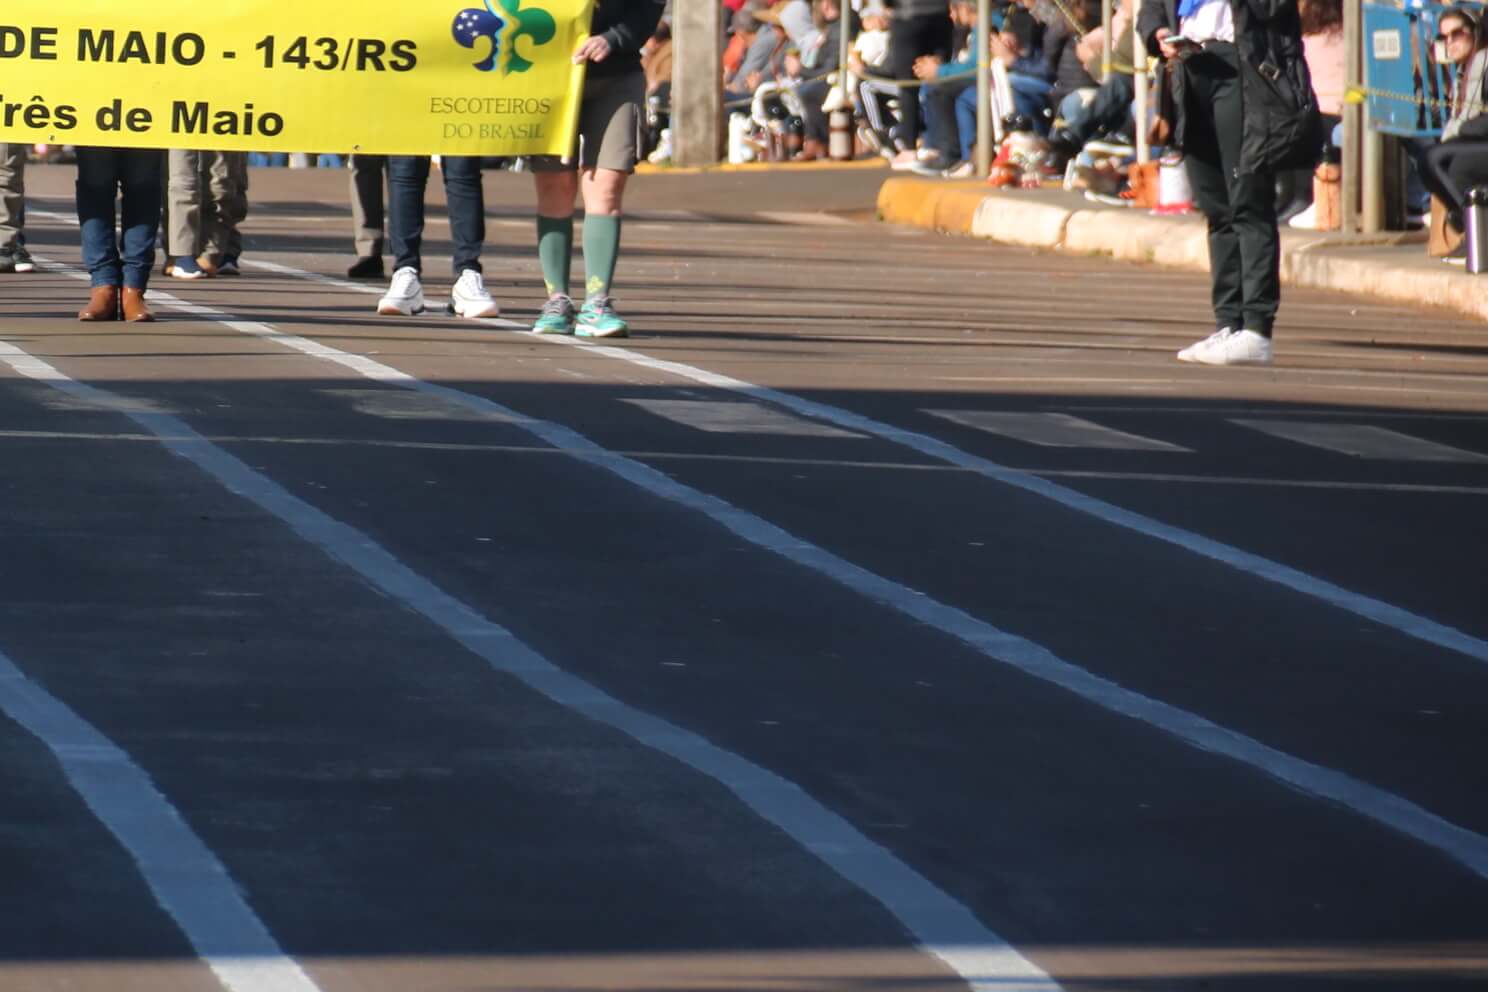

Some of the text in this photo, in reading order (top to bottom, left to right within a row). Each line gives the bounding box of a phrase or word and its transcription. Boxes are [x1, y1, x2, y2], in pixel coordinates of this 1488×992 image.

[77, 28, 206, 66] MAIO
[255, 35, 418, 72] 143/RS
[95, 98, 153, 133] de
[171, 100, 284, 137] Maio
[429, 96, 552, 115] ESCOTEIROS
[442, 122, 546, 140] DO BRASIL
